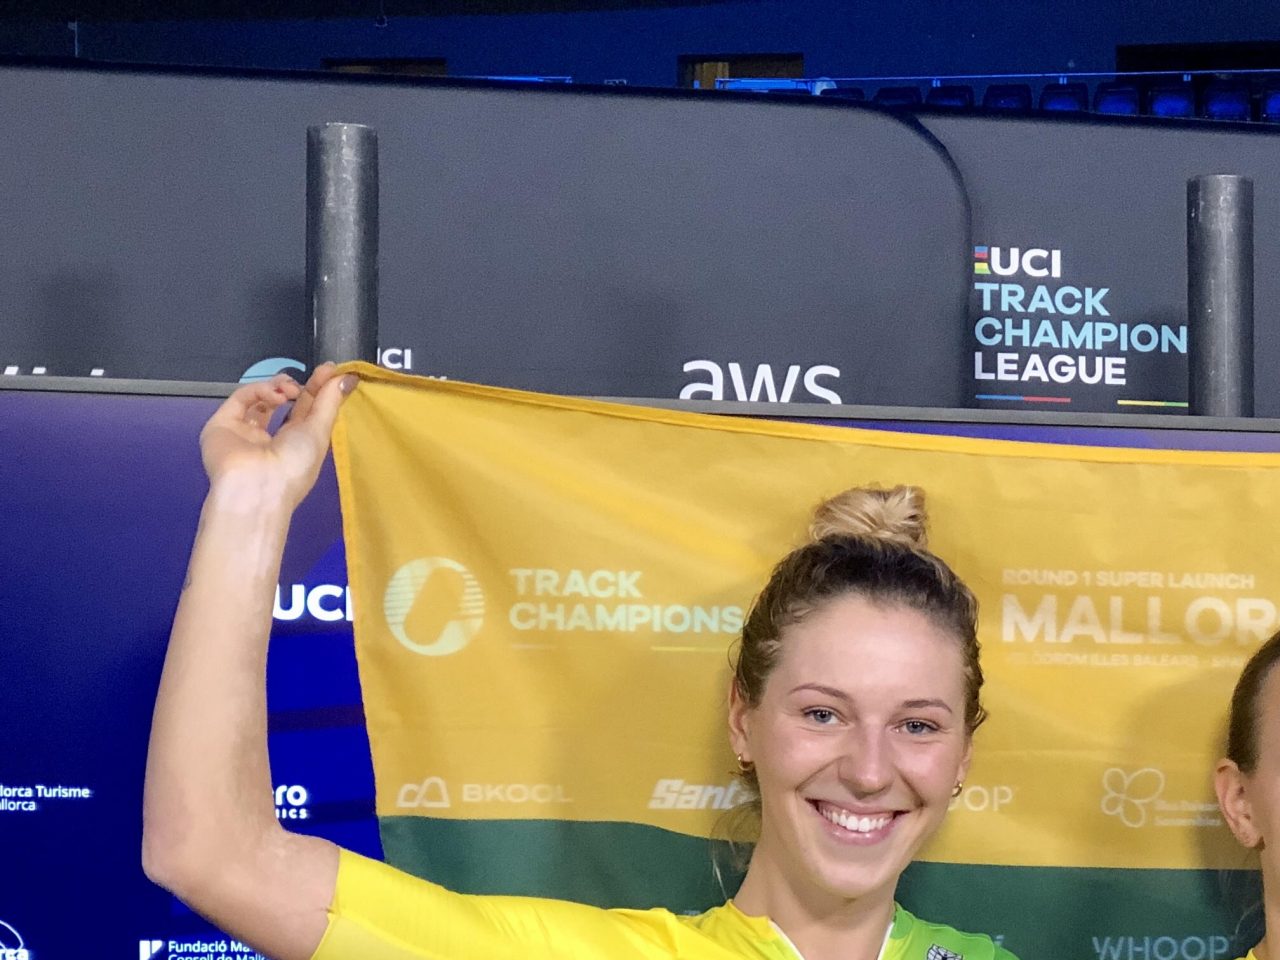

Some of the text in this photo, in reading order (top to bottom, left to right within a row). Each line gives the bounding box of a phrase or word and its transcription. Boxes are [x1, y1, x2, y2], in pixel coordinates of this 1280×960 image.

[990, 246, 1062, 278] UCI
[974, 282, 1110, 316] TRACK
[377, 347, 412, 370] CI
[974, 352, 1126, 386] LEAGUE
[509, 568, 644, 598] TRACK
[1002, 569, 1078, 586] ROUND
[1096, 571, 1164, 588] SUPER
[1168, 573, 1256, 590] LAUNCH
[508, 601, 744, 634] CHAMPIONS
[35, 784, 91, 799] Turisme
[168, 940, 228, 953] Fundació
